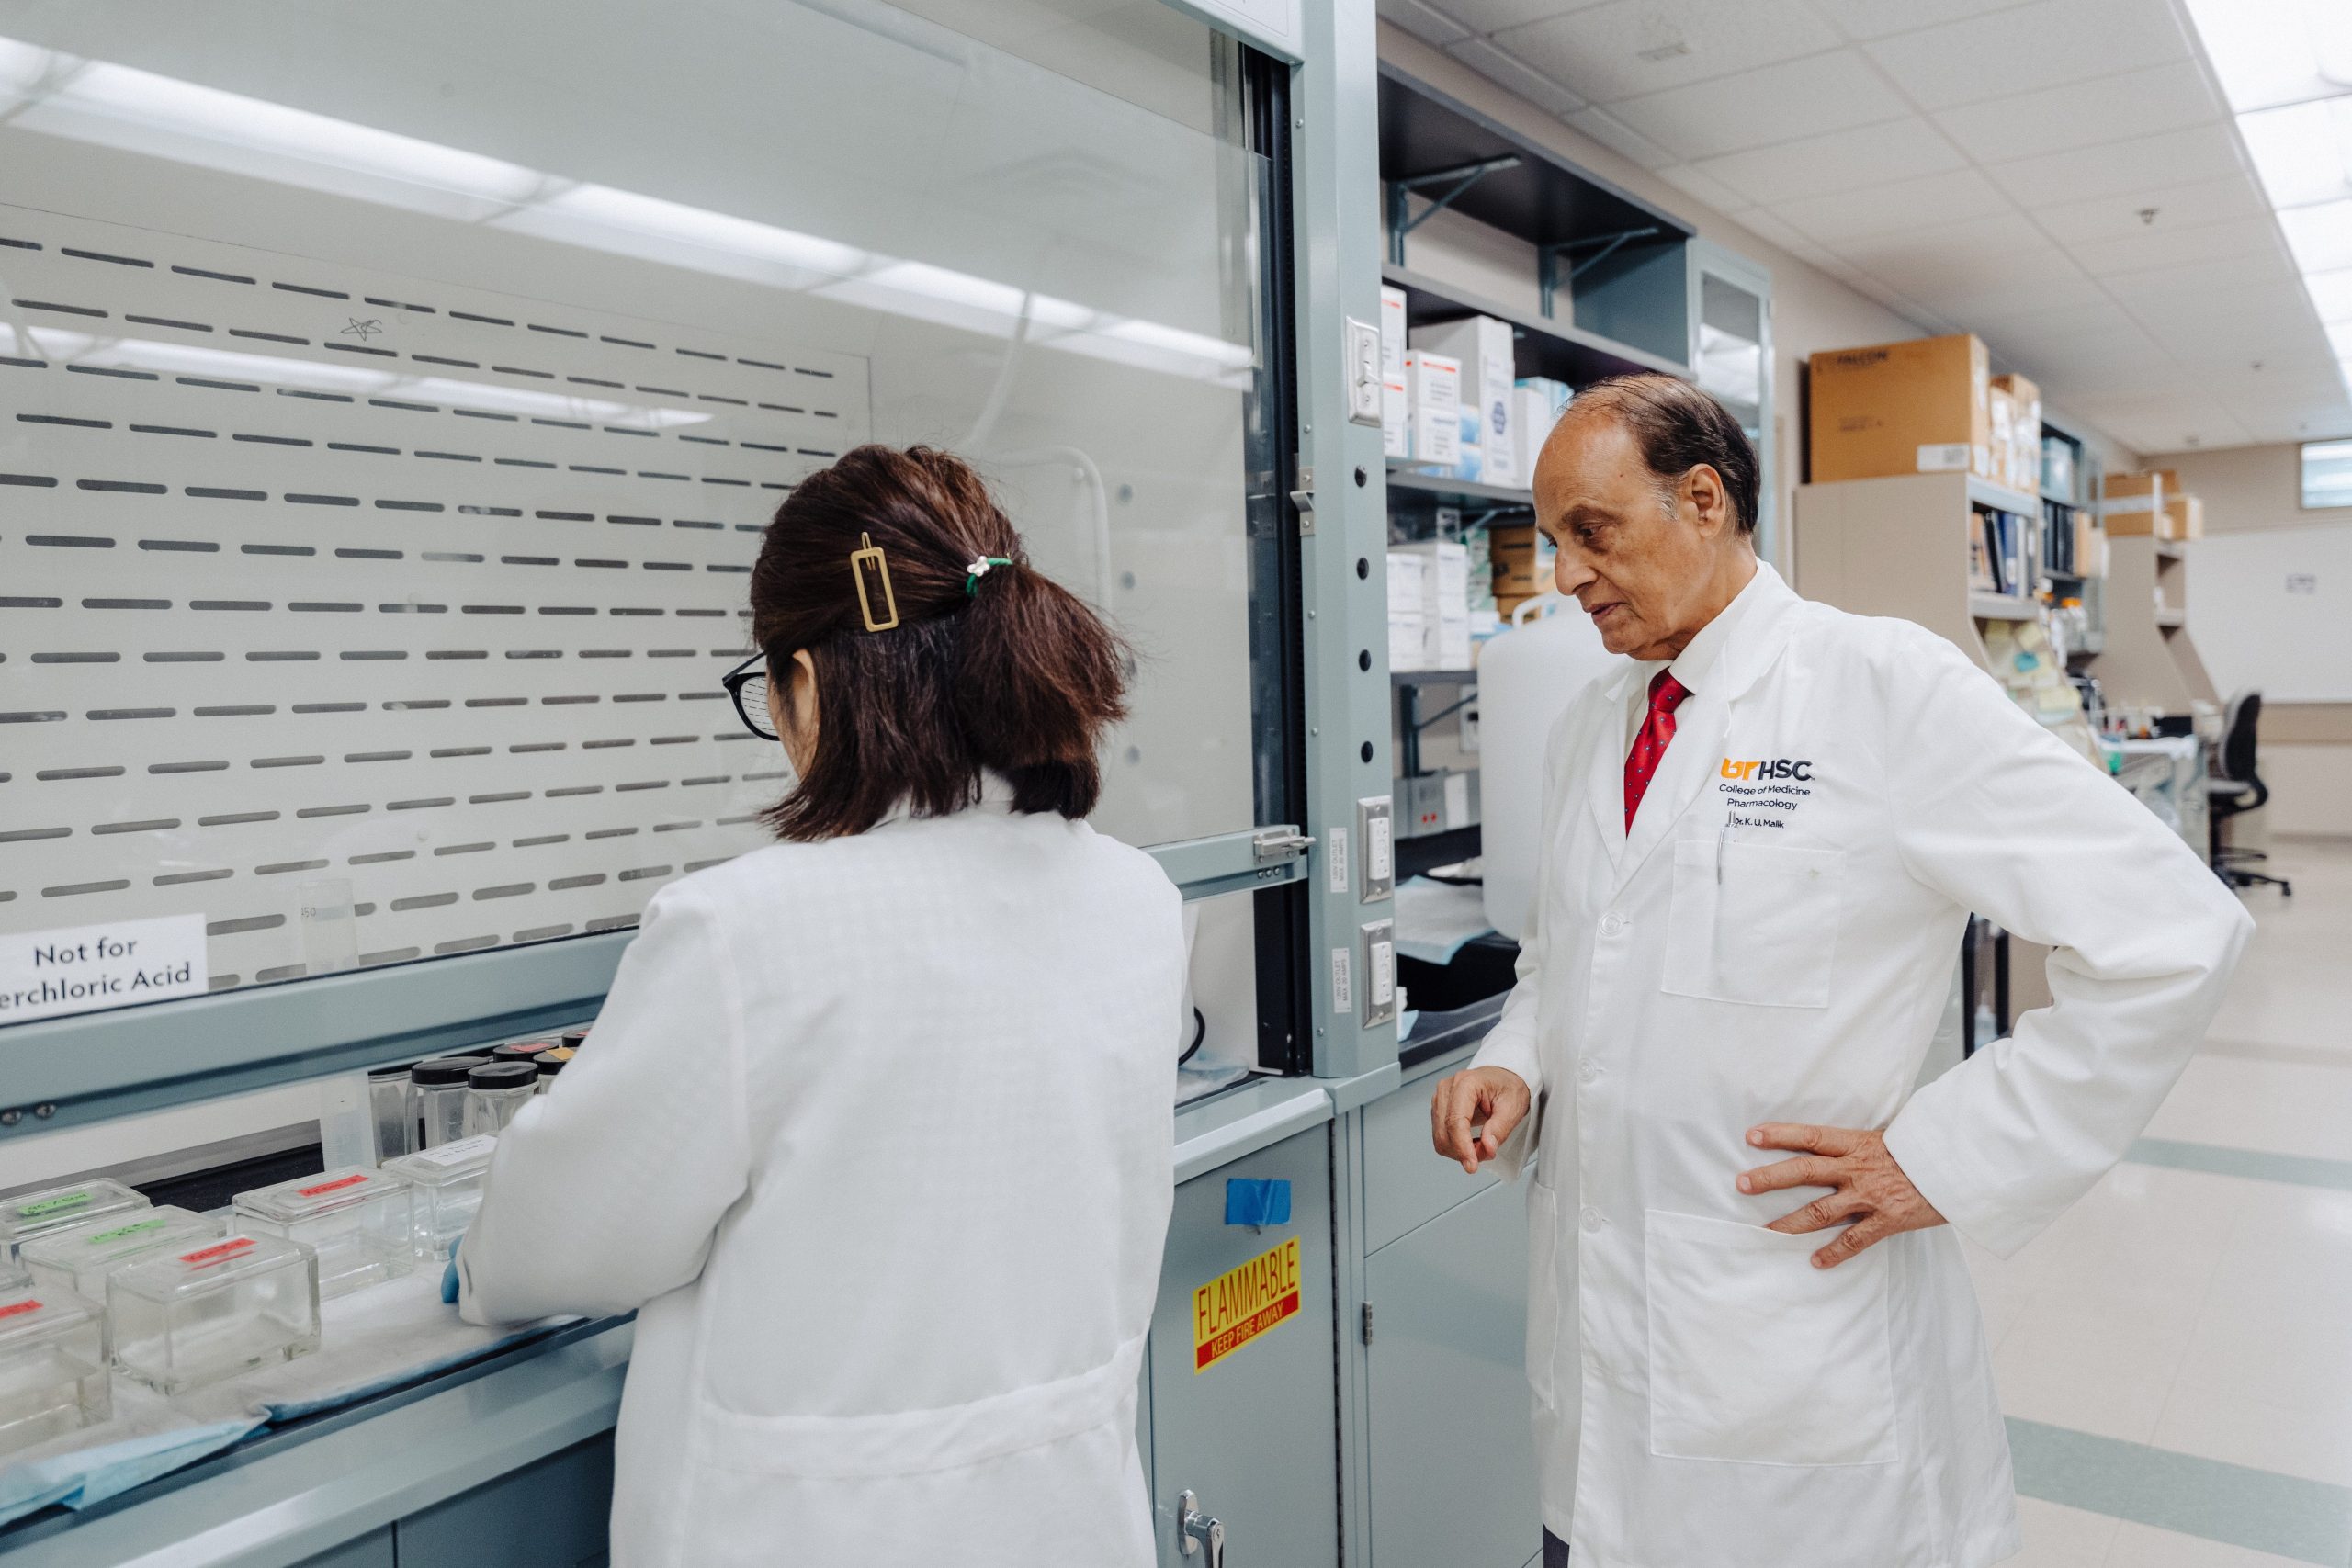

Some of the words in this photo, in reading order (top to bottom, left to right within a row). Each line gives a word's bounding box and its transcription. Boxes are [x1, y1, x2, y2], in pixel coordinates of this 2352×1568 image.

[1719, 784, 1756, 795] College
[1757, 785, 1767, 795] of
[1768, 784, 1811, 795] Medicine
[1727, 797, 1798, 811] Pharmacology
[1745, 818, 1753, 826] K.
[1754, 818, 1762, 827] U.
[1763, 818, 1784, 828] Malik
[35, 943, 87, 967] Not
[97, 936, 138, 960] for
[0, 974, 122, 1009] erchloric
[130, 961, 191, 991] Acid
[1198, 1241, 1295, 1340] FLAMMABLE
[1211, 1331, 1235, 1359] KEEP
[1236, 1317, 1256, 1344] FIRE
[1256, 1302, 1284, 1332] AWAY
